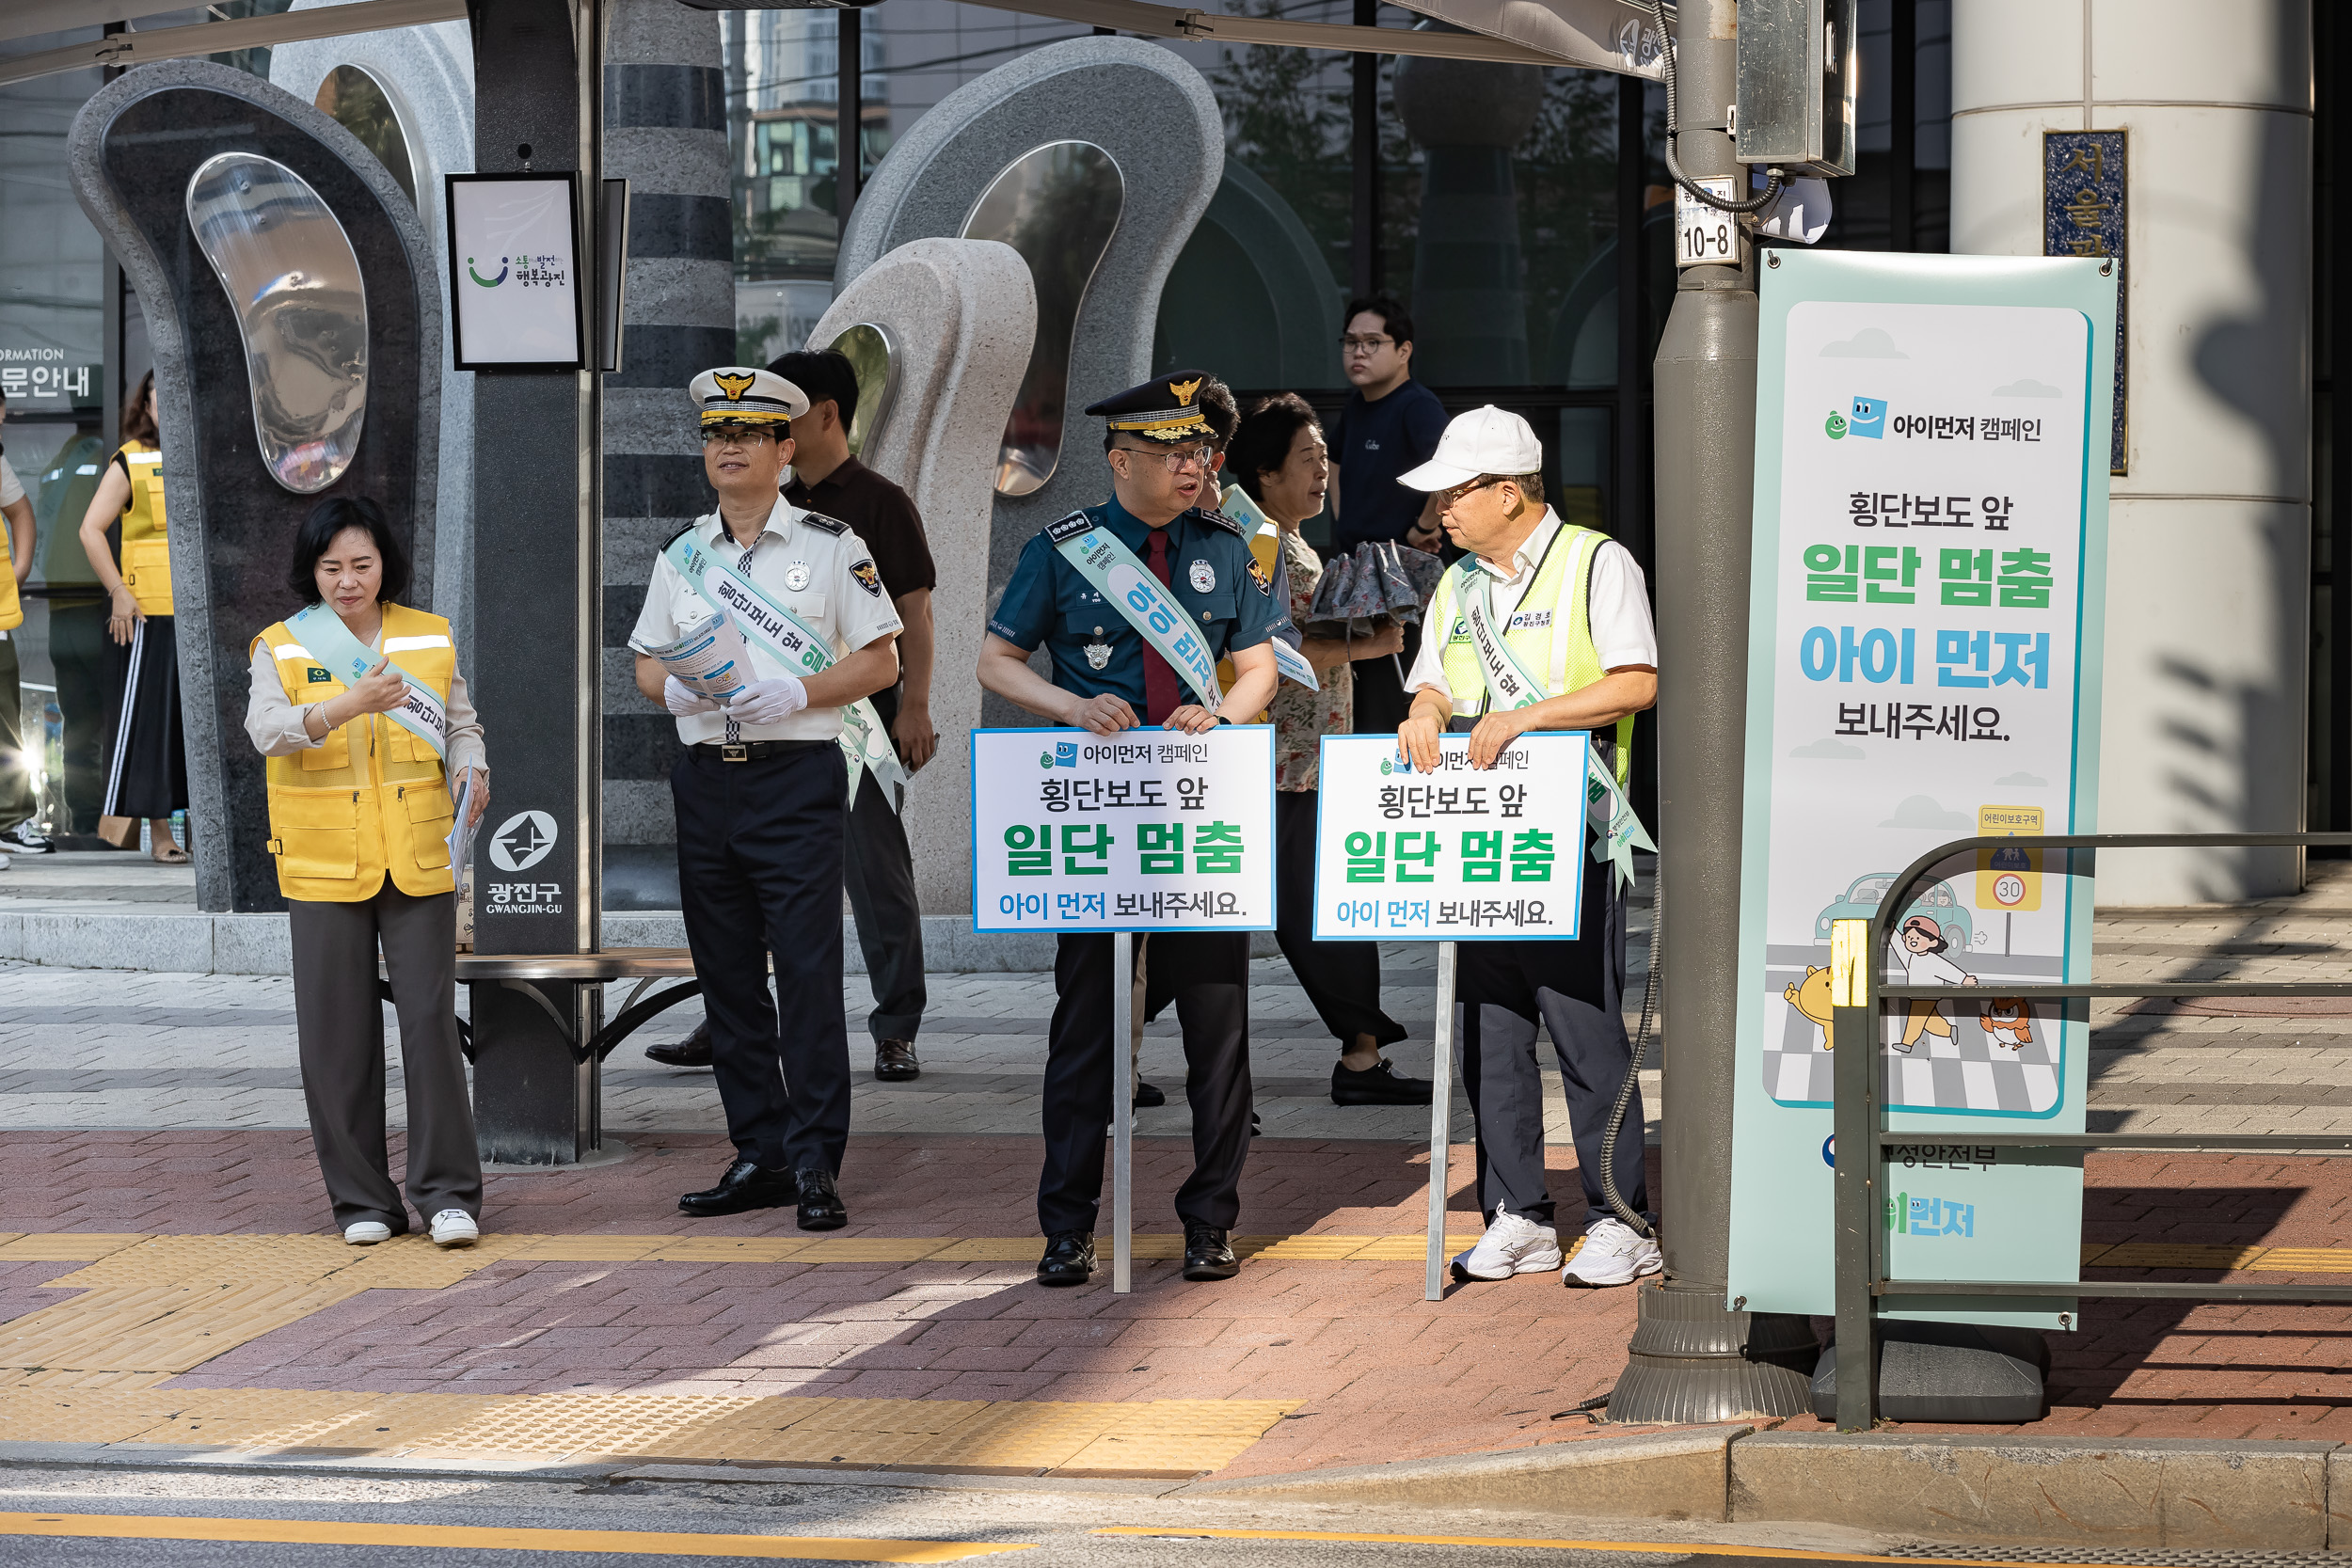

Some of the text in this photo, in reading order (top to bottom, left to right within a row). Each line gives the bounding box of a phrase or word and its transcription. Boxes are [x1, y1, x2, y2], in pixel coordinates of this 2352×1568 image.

[1685, 225, 1728, 258] 10-8
[516, 269, 564, 287] 행복광진
[2, 366, 89, 398] 문안내
[1893, 415, 2042, 442] 아이먼저 캠페인
[1849, 492, 2014, 531] 횡단보도 앞
[1804, 544, 2054, 609] 일단 멈춤
[1127, 581, 1178, 634] 아이
[1172, 631, 1212, 687] 먼저
[1801, 626, 2050, 689] 아이 먼저
[1835, 703, 2010, 741] 보내주세요.
[1083, 743, 1208, 764] 아이먼저 캠페인
[1439, 751, 1473, 770] 이먼
[1040, 777, 1208, 812] 횡단보도 앞
[1378, 784, 1527, 818] 횡단보도 앞
[1984, 814, 2038, 825] 어린이보호구역
[1004, 820, 1244, 876] 일단 멈춤
[1344, 828, 1555, 882] 일단 멈춤
[488, 883, 562, 903] 광진구
[1999, 881, 2020, 897] 30
[486, 904, 563, 914] GWANGJIN-GU
[999, 891, 1247, 920] 아이 먼저 보내주세요.
[1337, 899, 1552, 927] 아이 먼저 보내주세요.
[1888, 1145, 1996, 1171] 정안전부
[1886, 1192, 1975, 1237] 이먼저
